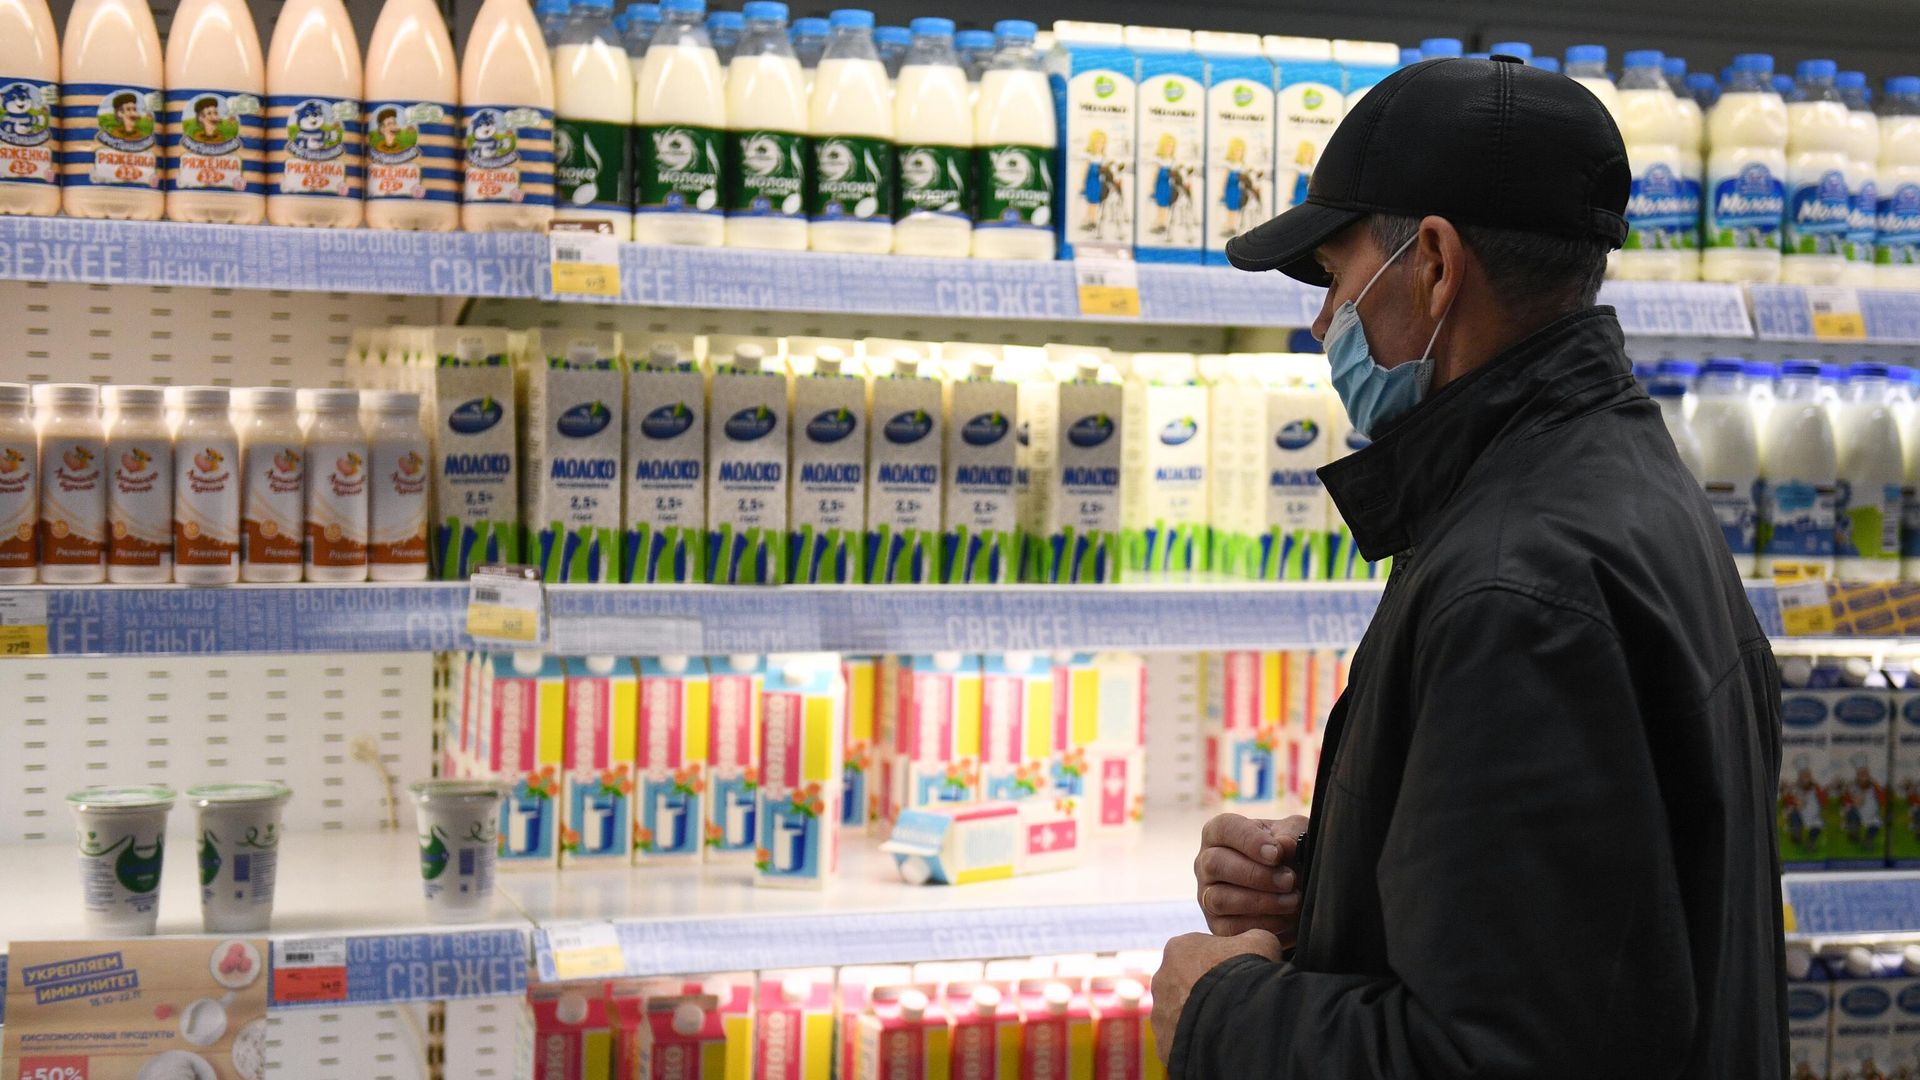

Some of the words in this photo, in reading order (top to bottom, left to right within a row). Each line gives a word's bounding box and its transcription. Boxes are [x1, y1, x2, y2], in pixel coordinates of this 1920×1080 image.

[149, 260, 241, 286] ДЕНЬГИ
[444, 454, 512, 476] МОЛОКО
[551, 458, 617, 480] МОЛОКО
[636, 459, 701, 481] МОЛОКО
[719, 462, 782, 482] МОЛОКО
[801, 463, 861, 484] МОЛОКО
[878, 464, 938, 485] МОЛОКО
[124, 628, 217, 654] ДЕНЬГИ
[945, 614, 1070, 651] СВЕЖЕЕ
[27, 955, 119, 983] УКРЕПЛЯЕМ
[385, 955, 527, 1000] СВЕЖЕЕ
[40, 972, 134, 1001] ИММУНИТЕТ
[21, 1031, 117, 1042] КИСЛОМОЛОЧНЫЕ
[120, 1030, 175, 1040] ПРОДУКТЫ
